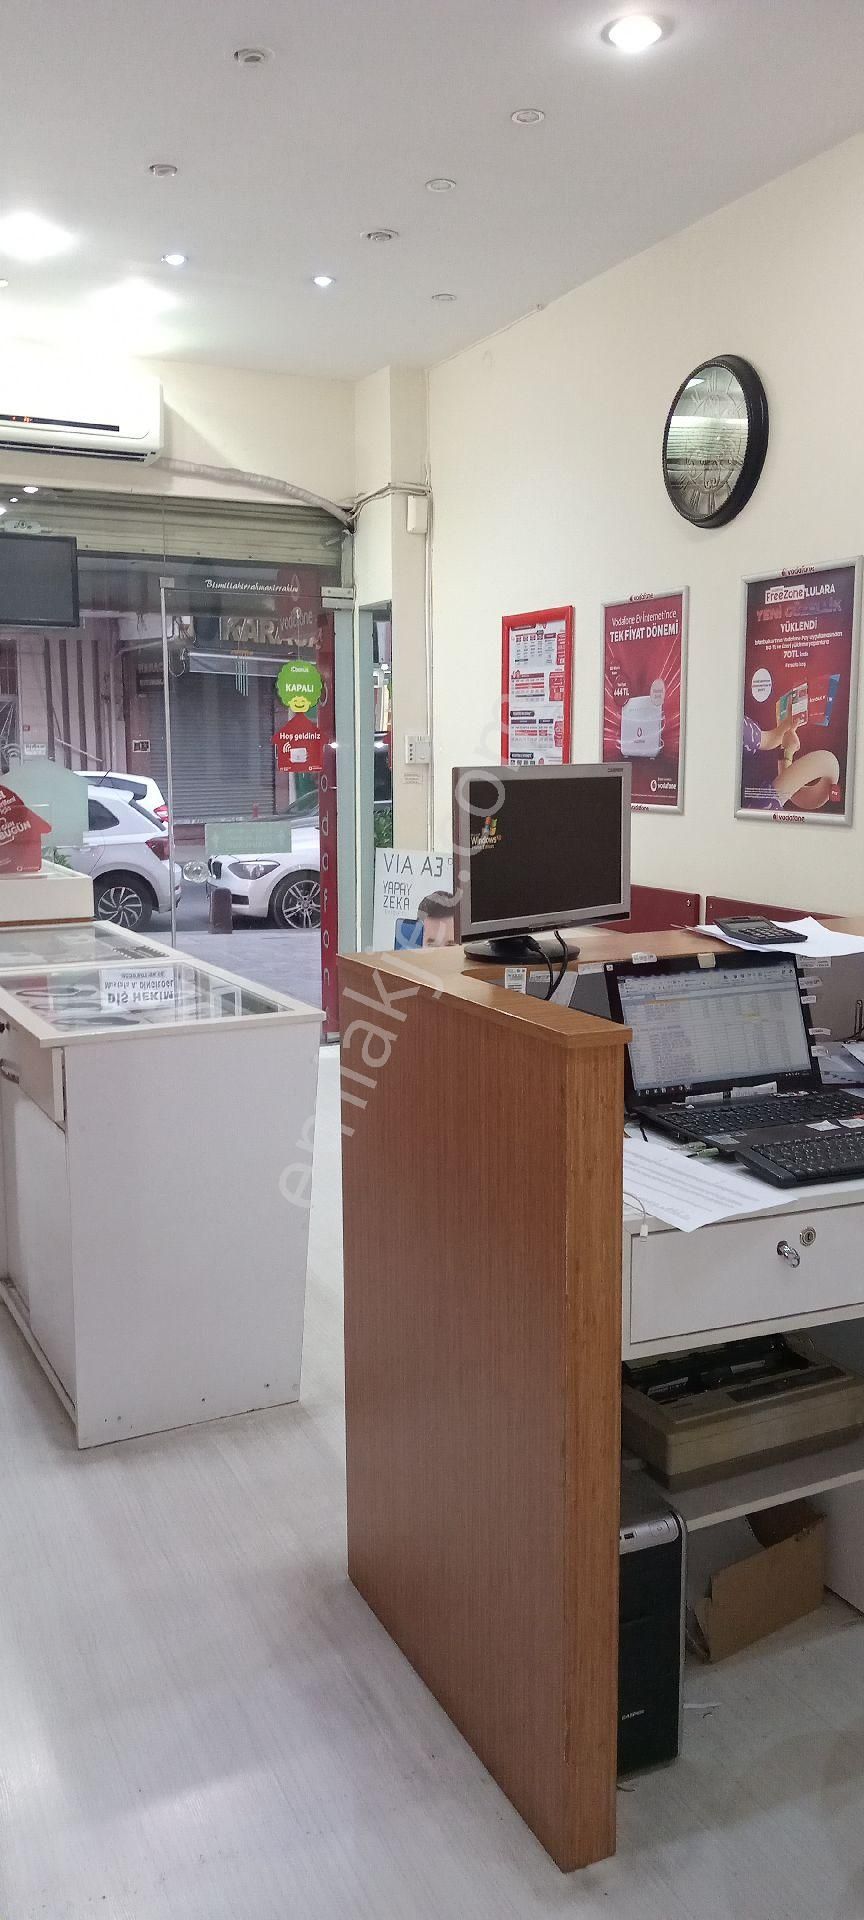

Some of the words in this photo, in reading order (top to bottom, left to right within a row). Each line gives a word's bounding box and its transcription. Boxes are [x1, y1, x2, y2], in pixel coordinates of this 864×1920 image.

[611, 615, 636, 626] Vodafone
[781, 617, 817, 633] YÜKLENDİ
[610, 630, 624, 643] TEK
[625, 626, 645, 641] FİYAT
[646, 620, 679, 638] DÖNEMİ
[285, 683, 314, 693] KAPALI
[279, 732, 293, 742] Hoş
[294, 732, 320, 742] geldiniz
[470, 836, 497, 846] Windows
[383, 852, 413, 875] VIA
[420, 856, 443, 877] A3
[383, 880, 412, 896] YAPAY
[383, 895, 410, 911] ZEKA
